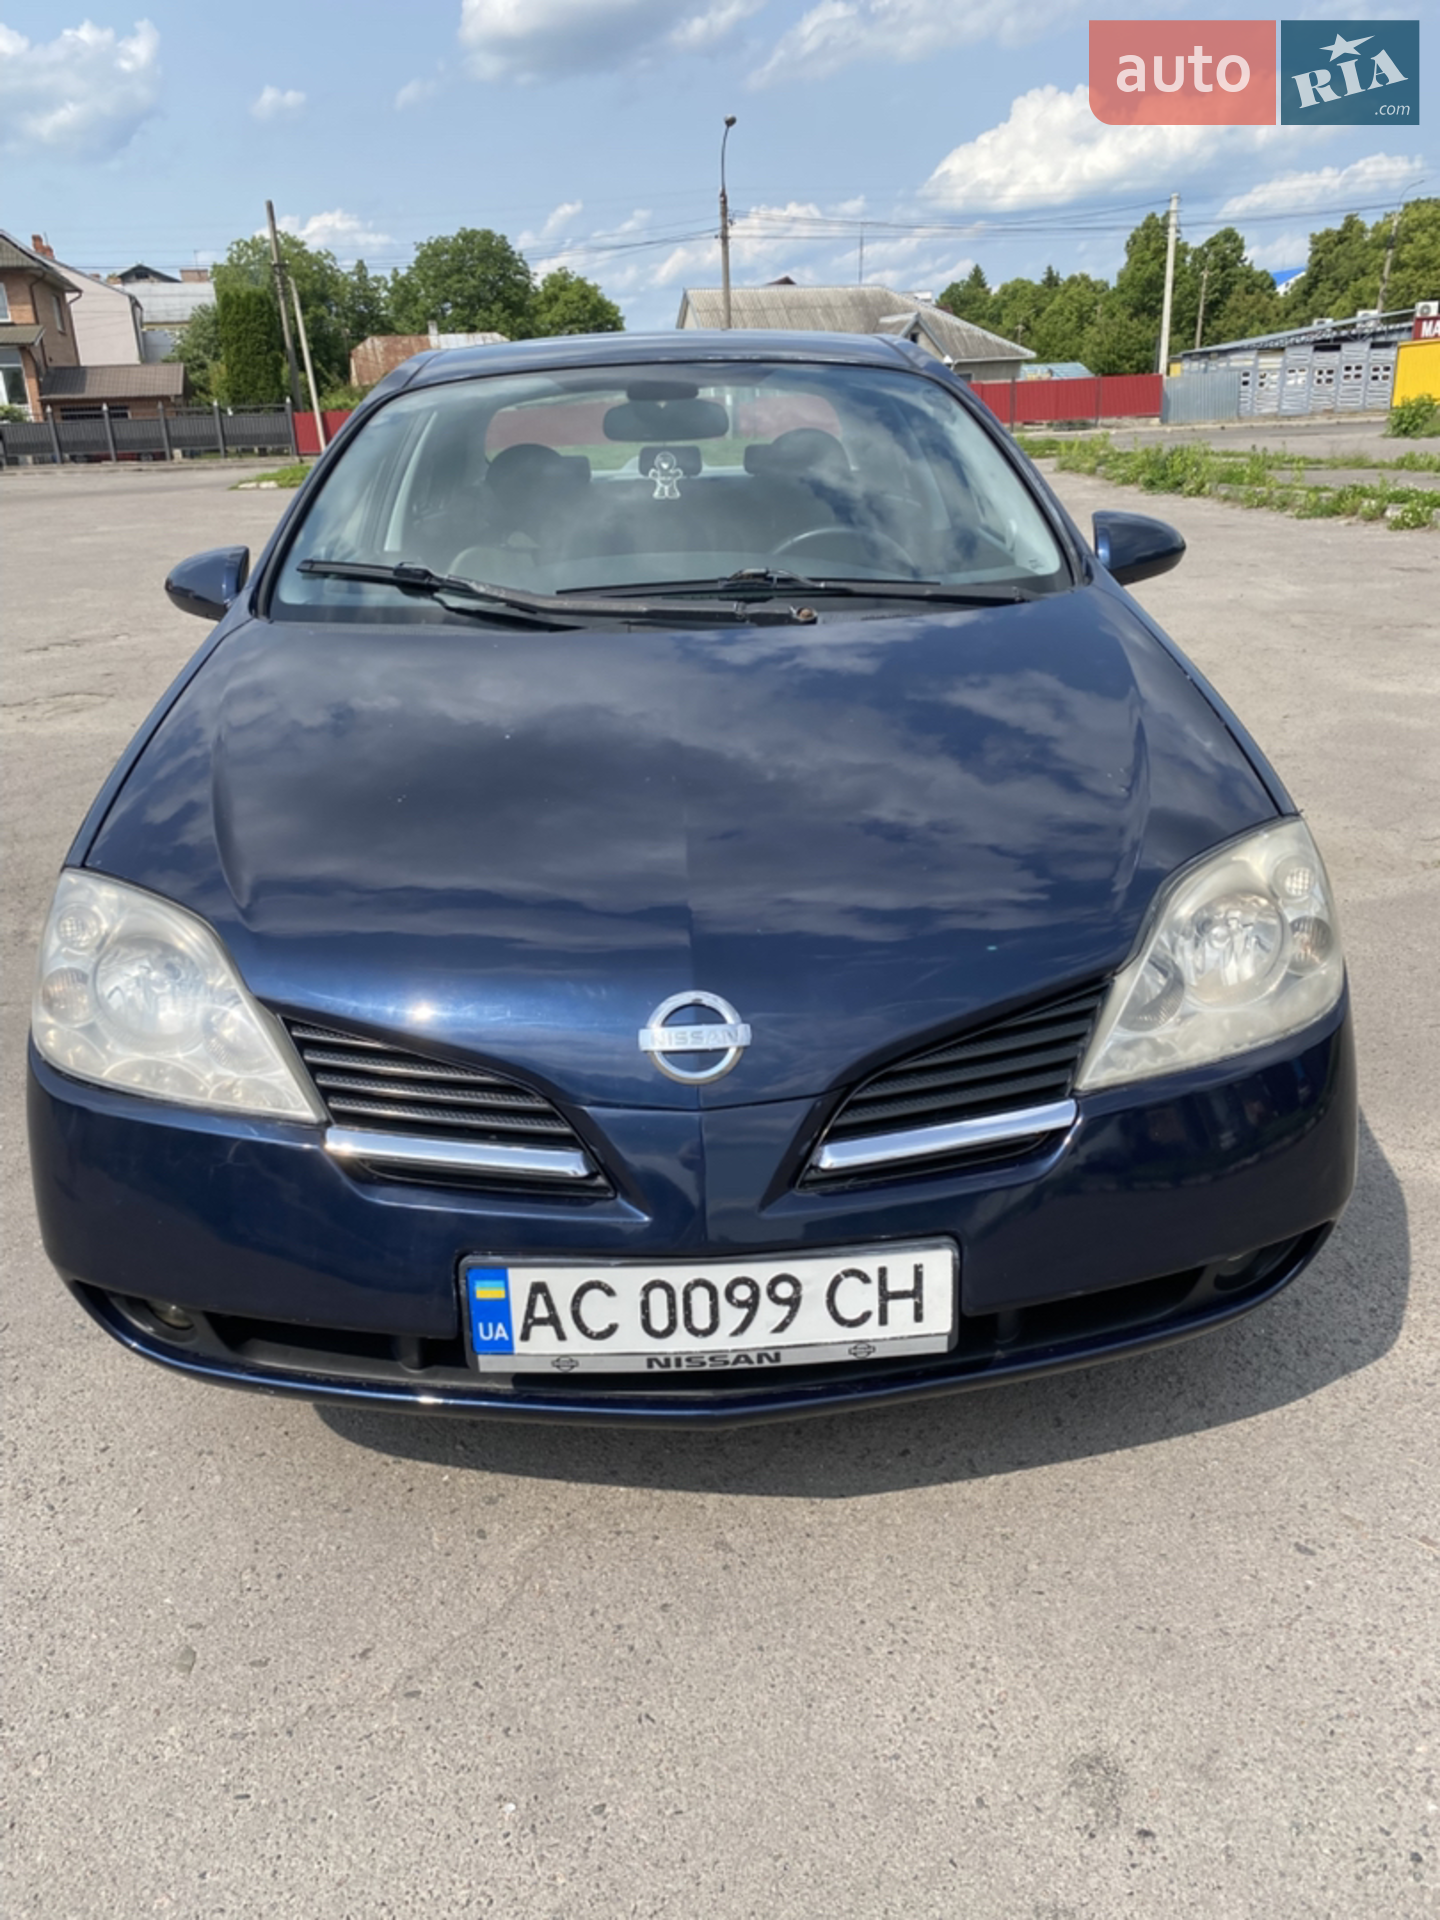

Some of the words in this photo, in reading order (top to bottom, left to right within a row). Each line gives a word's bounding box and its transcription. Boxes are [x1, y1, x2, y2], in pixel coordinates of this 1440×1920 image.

[650, 1029, 740, 1047] NISSAN
[519, 1279, 619, 1342] AC
[639, 1273, 803, 1340] 0099
[825, 1263, 924, 1329] CH
[478, 1321, 509, 1343] UA
[646, 1350, 782, 1370] NISSAN
